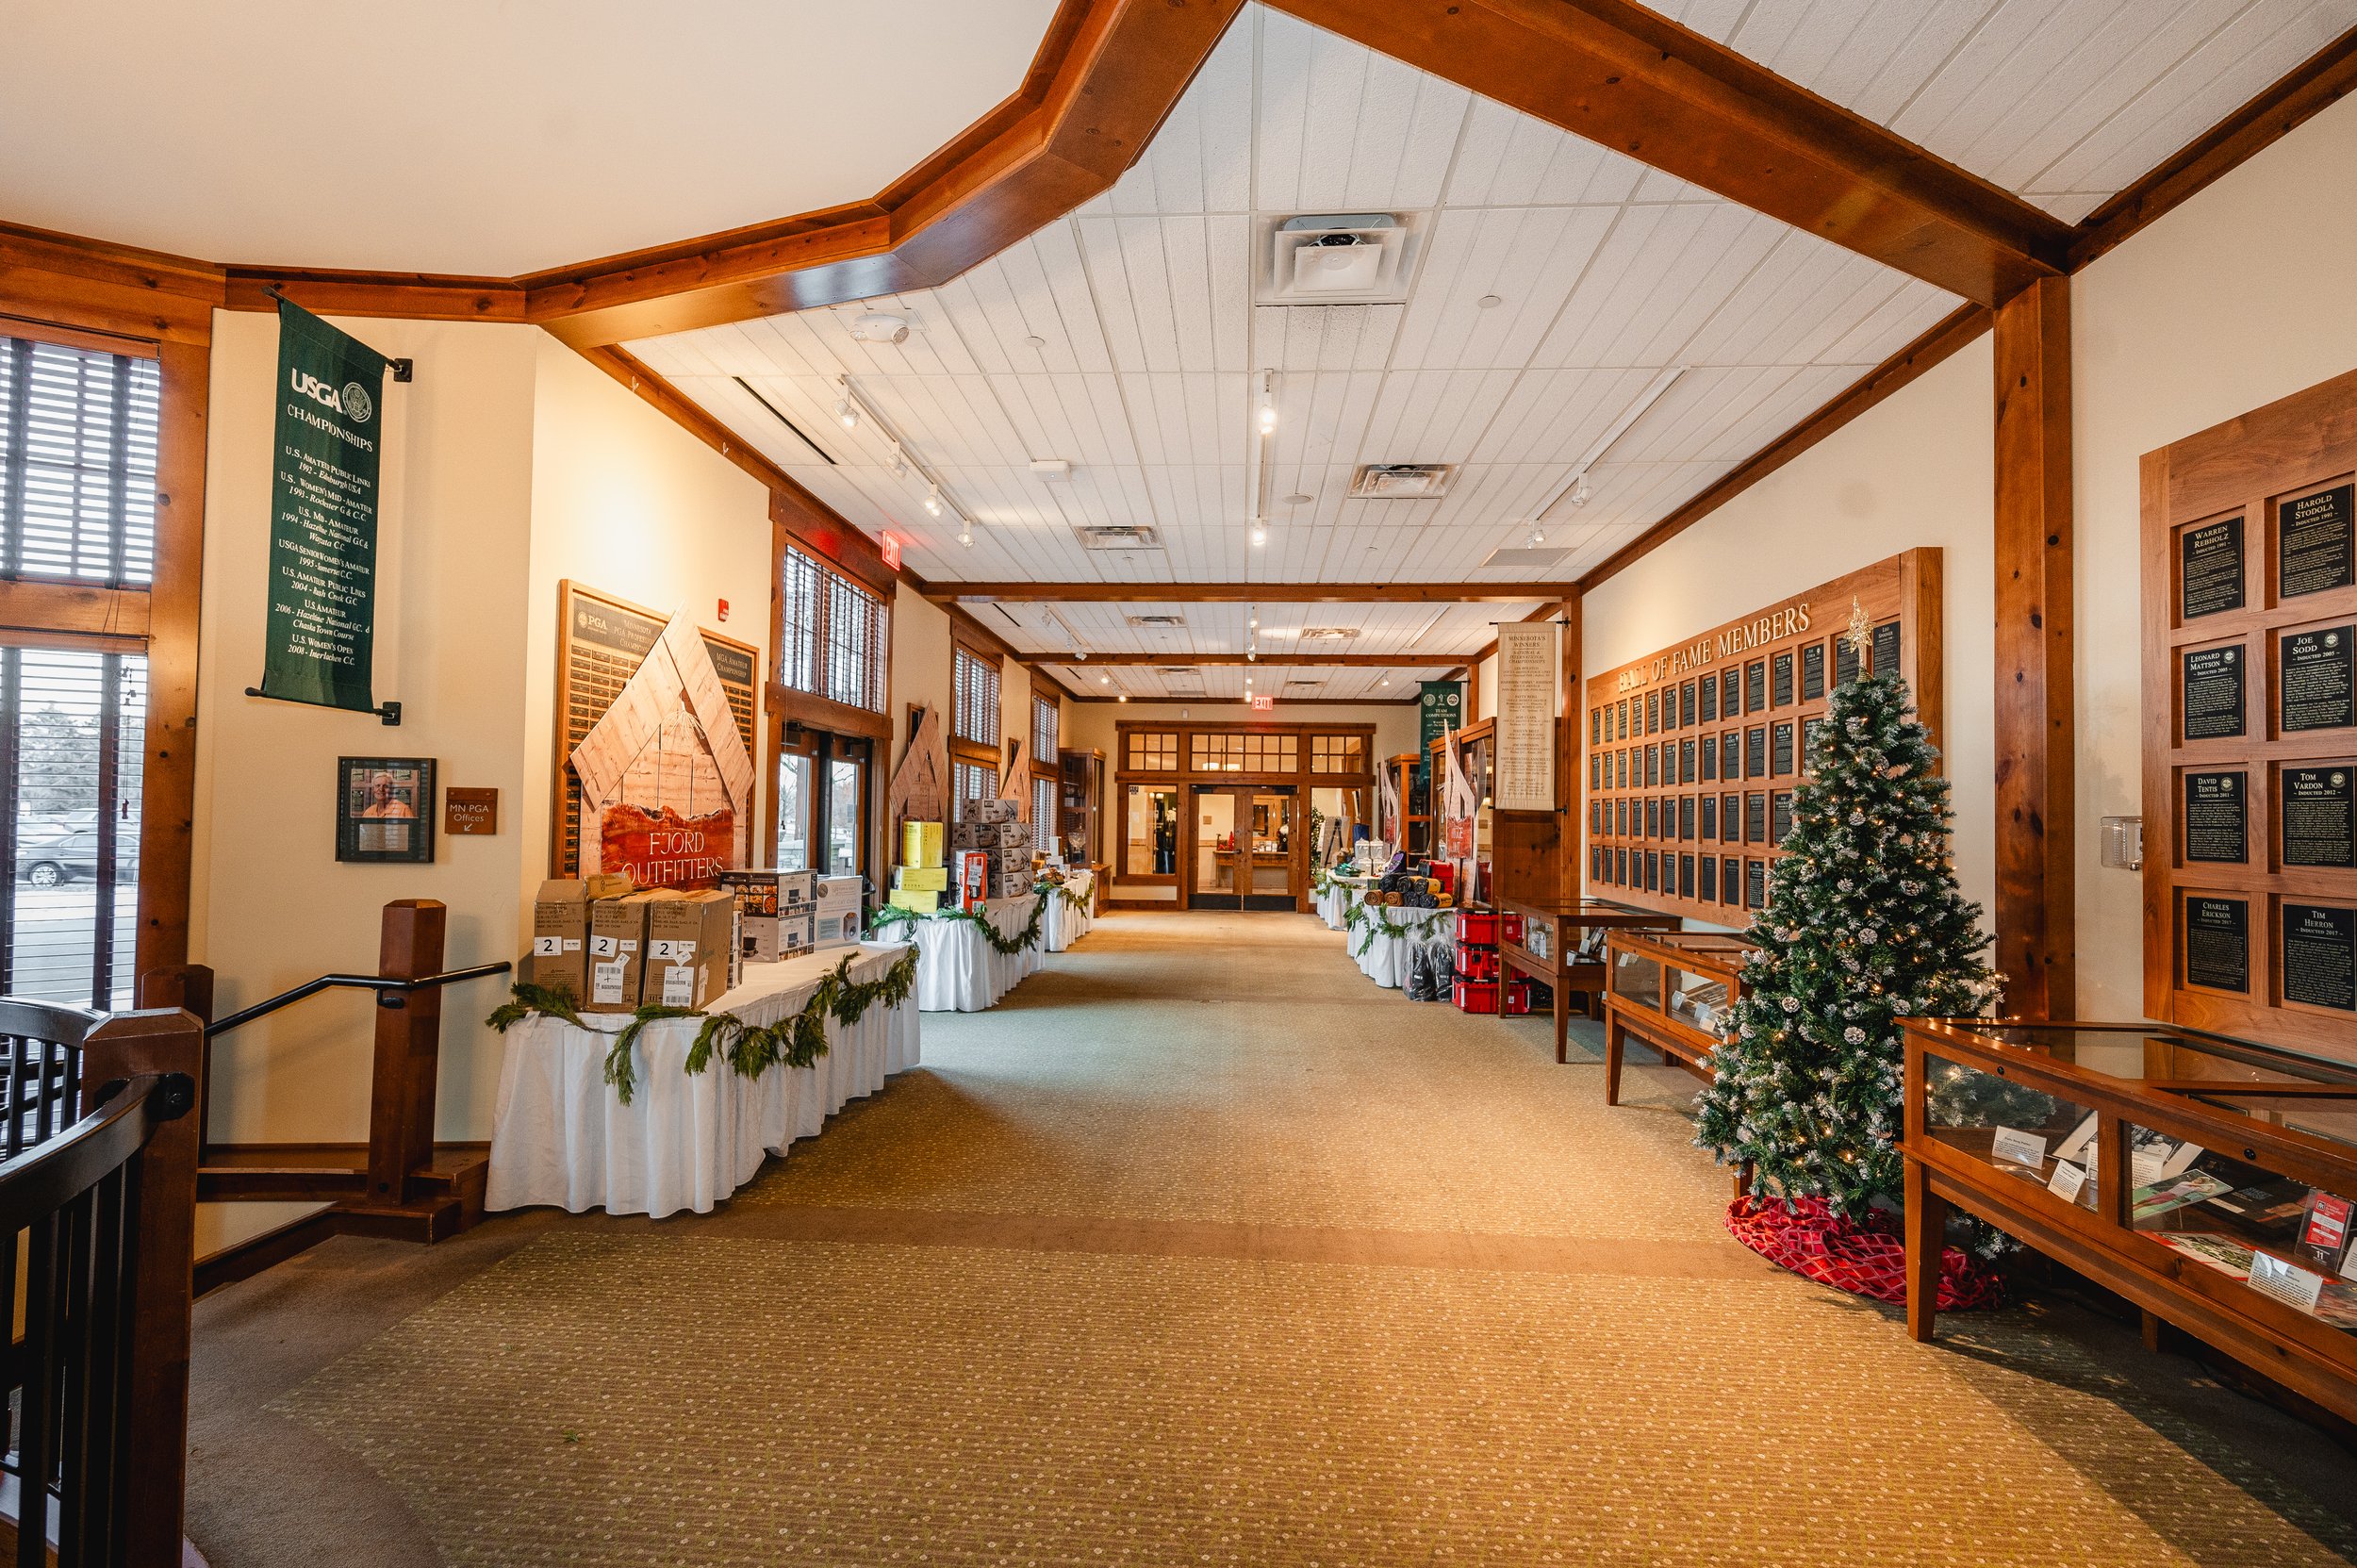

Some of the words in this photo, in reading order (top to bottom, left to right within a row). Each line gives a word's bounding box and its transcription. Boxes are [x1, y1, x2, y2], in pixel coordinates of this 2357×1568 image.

[292, 368, 342, 413] USGA
[288, 404, 372, 452] CHAMPIONSHIPS
[286, 446, 302, 458] U.S.
[331, 466, 352, 480] PUBLIC
[353, 475, 370, 488] LINKS
[281, 471, 295, 484] U.S.
[299, 462, 312, 474] 1992
[348, 483, 361, 494] USA
[289, 486, 305, 498] 1993
[2297, 495, 2332, 510] HAROLD
[298, 506, 311, 518] U.S.
[2295, 503, 2334, 519] STODOLA
[282, 512, 298, 523] 1994
[2296, 517, 2319, 526] INDUCTED
[2195, 525, 2227, 539] WARREN
[279, 539, 298, 552] USGA
[2195, 533, 2228, 548] REBHOLZ
[887, 535, 899, 566] EXIT
[299, 557, 314, 567] 1995
[283, 566, 295, 577] U.S.
[328, 581, 348, 593] PUBLIC
[292, 581, 308, 592] 2004
[275, 603, 291, 614] 2006
[305, 600, 316, 610] U.S.
[588, 615, 607, 629] PGA
[316, 625, 333, 635] Town
[334, 630, 354, 641] Course
[614, 626, 625, 636] PGA
[292, 634, 306, 644] U.S.
[337, 644, 353, 654] OPEN
[2297, 637, 2313, 645] JOE
[288, 645, 304, 655] 2008
[1618, 665, 1647, 693] HALL
[1652, 656, 1667, 680] OF
[1673, 639, 1711, 674] FAME
[1719, 603, 1809, 659] MEMBERS
[2293, 645, 2317, 654] SODD
[717, 652, 727, 663] MGA
[2191, 653, 2220, 662] LEONARD
[717, 663, 746, 678] CHAMPIONSHIP
[2190, 661, 2220, 670] MATTSON
[1255, 696, 1271, 709] EXIT
[469, 805, 489, 813] PGA
[650, 832, 704, 855] FJORD
[622, 856, 723, 884] OUTFITTERS
[2203, 902, 2229, 911] CHARLES
[2202, 909, 2230, 918] ERICKSON
[2312, 910, 2325, 919] TIM
[2305, 919, 2333, 928] HERRON
[544, 939, 553, 951] 2
[598, 939, 608, 952] 2
[660, 943, 669, 955] 2
[2316, 1251, 2324, 1260] 11
